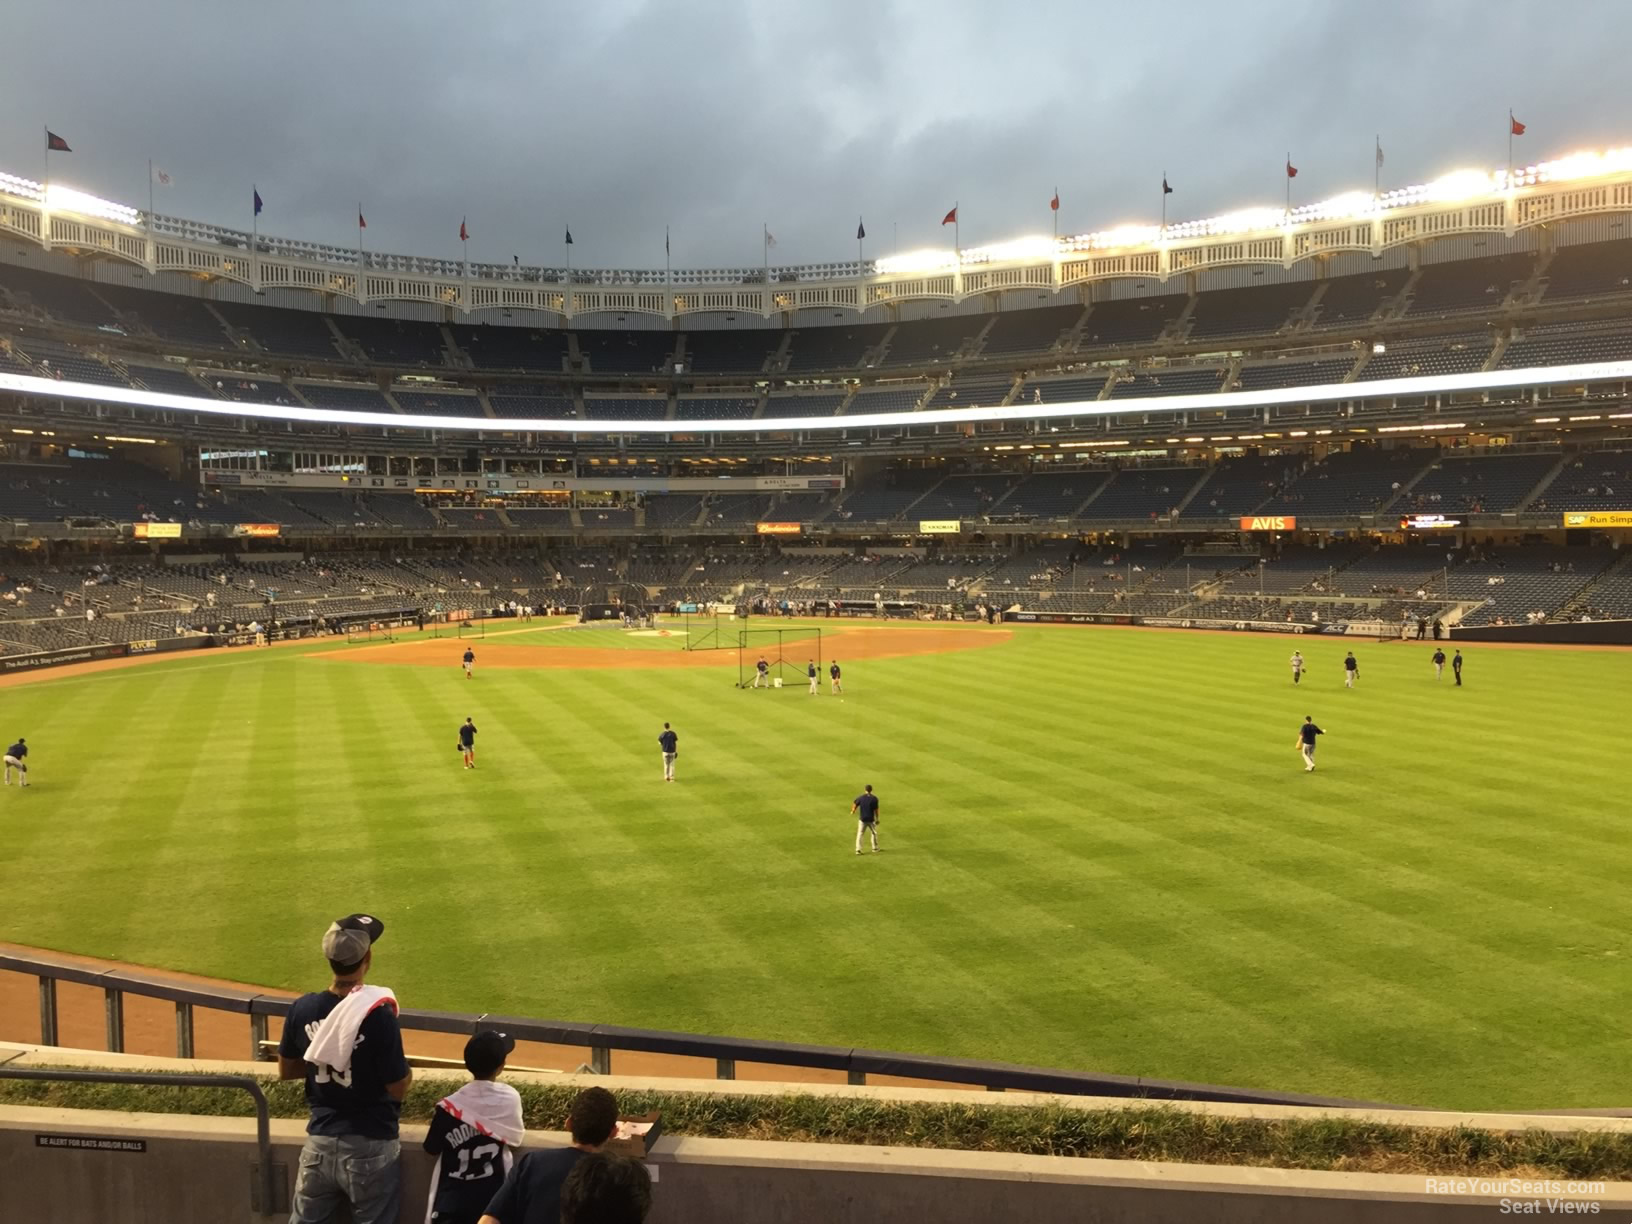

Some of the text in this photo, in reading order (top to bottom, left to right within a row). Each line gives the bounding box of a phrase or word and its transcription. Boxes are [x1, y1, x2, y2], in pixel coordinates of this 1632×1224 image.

[1251, 517, 1285, 530] AVIS
[1568, 516, 1586, 524] SAP
[756, 523, 800, 533] Budweiser
[16, 659, 29, 667] Audi
[40, 657, 51, 665] Stay
[40, 1137, 142, 1150] BE ALERT FOR BATS AND/OR BALLS
[448, 1143, 500, 1180] 13
